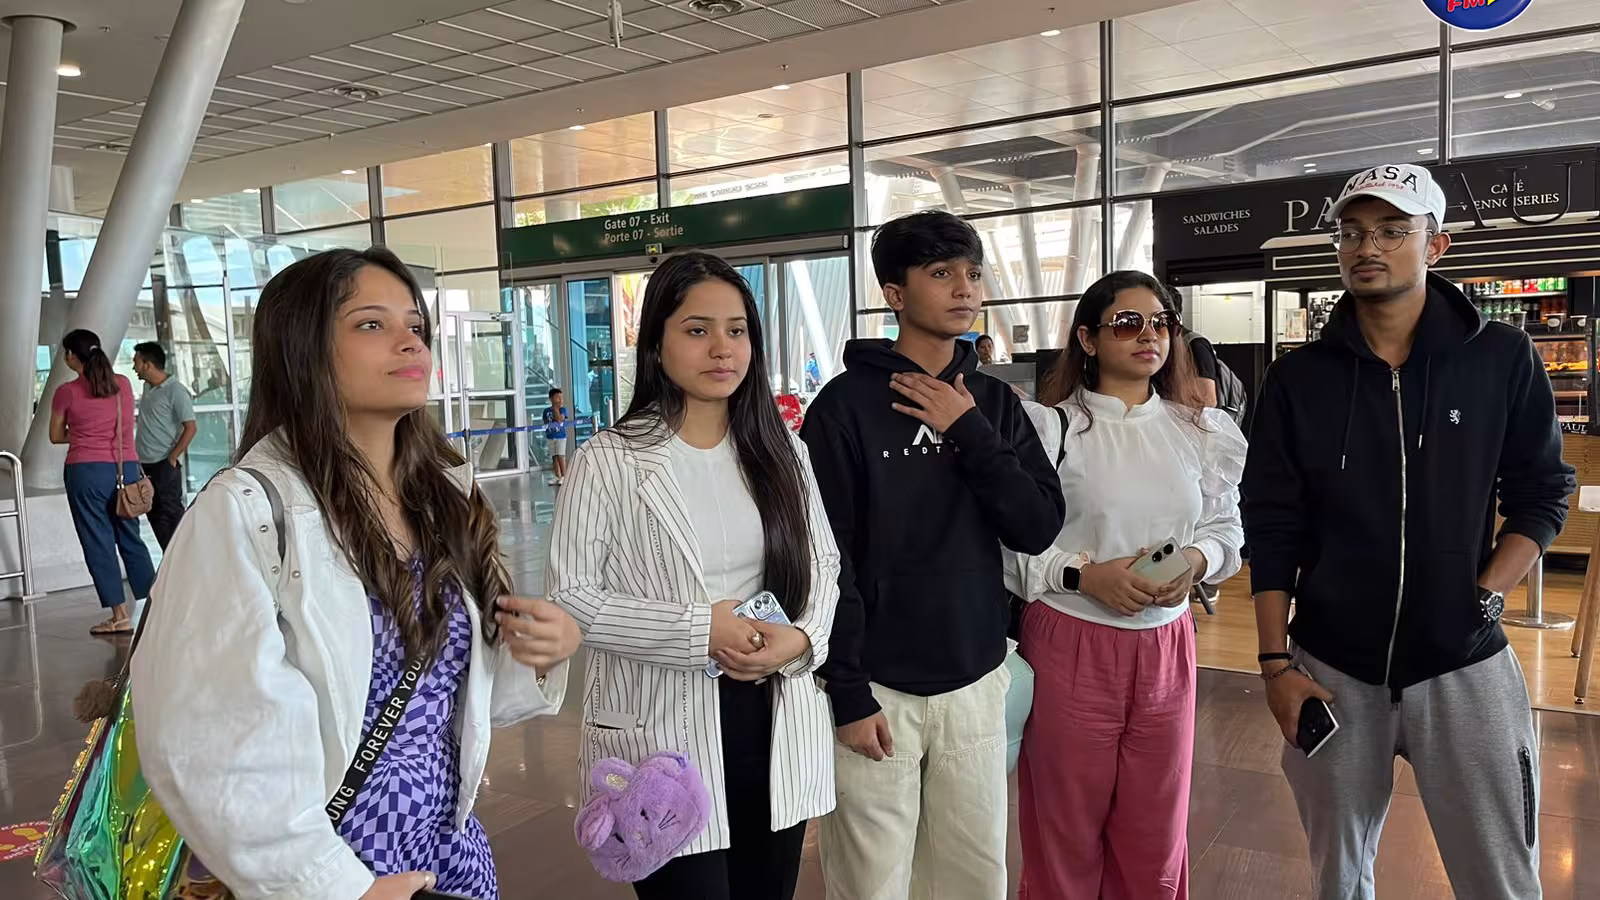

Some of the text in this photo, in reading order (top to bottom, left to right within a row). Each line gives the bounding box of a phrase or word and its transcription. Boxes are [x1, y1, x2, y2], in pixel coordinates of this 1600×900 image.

[1344, 166, 1418, 194] NASA
[1490, 179, 1525, 195] CAÉ
[1461, 192, 1560, 211] VENNISERIES
[604, 217, 627, 230] Gate
[629, 216, 641, 227] 07
[650, 212, 670, 225] Exit
[1183, 209, 1251, 225] SANDWICHES
[604, 232, 630, 243] Porte
[632, 229, 644, 240] 07
[653, 224, 684, 239] Sortie
[1194, 222, 1240, 236] SALADES
[353, 695, 406, 773] FOREVER
